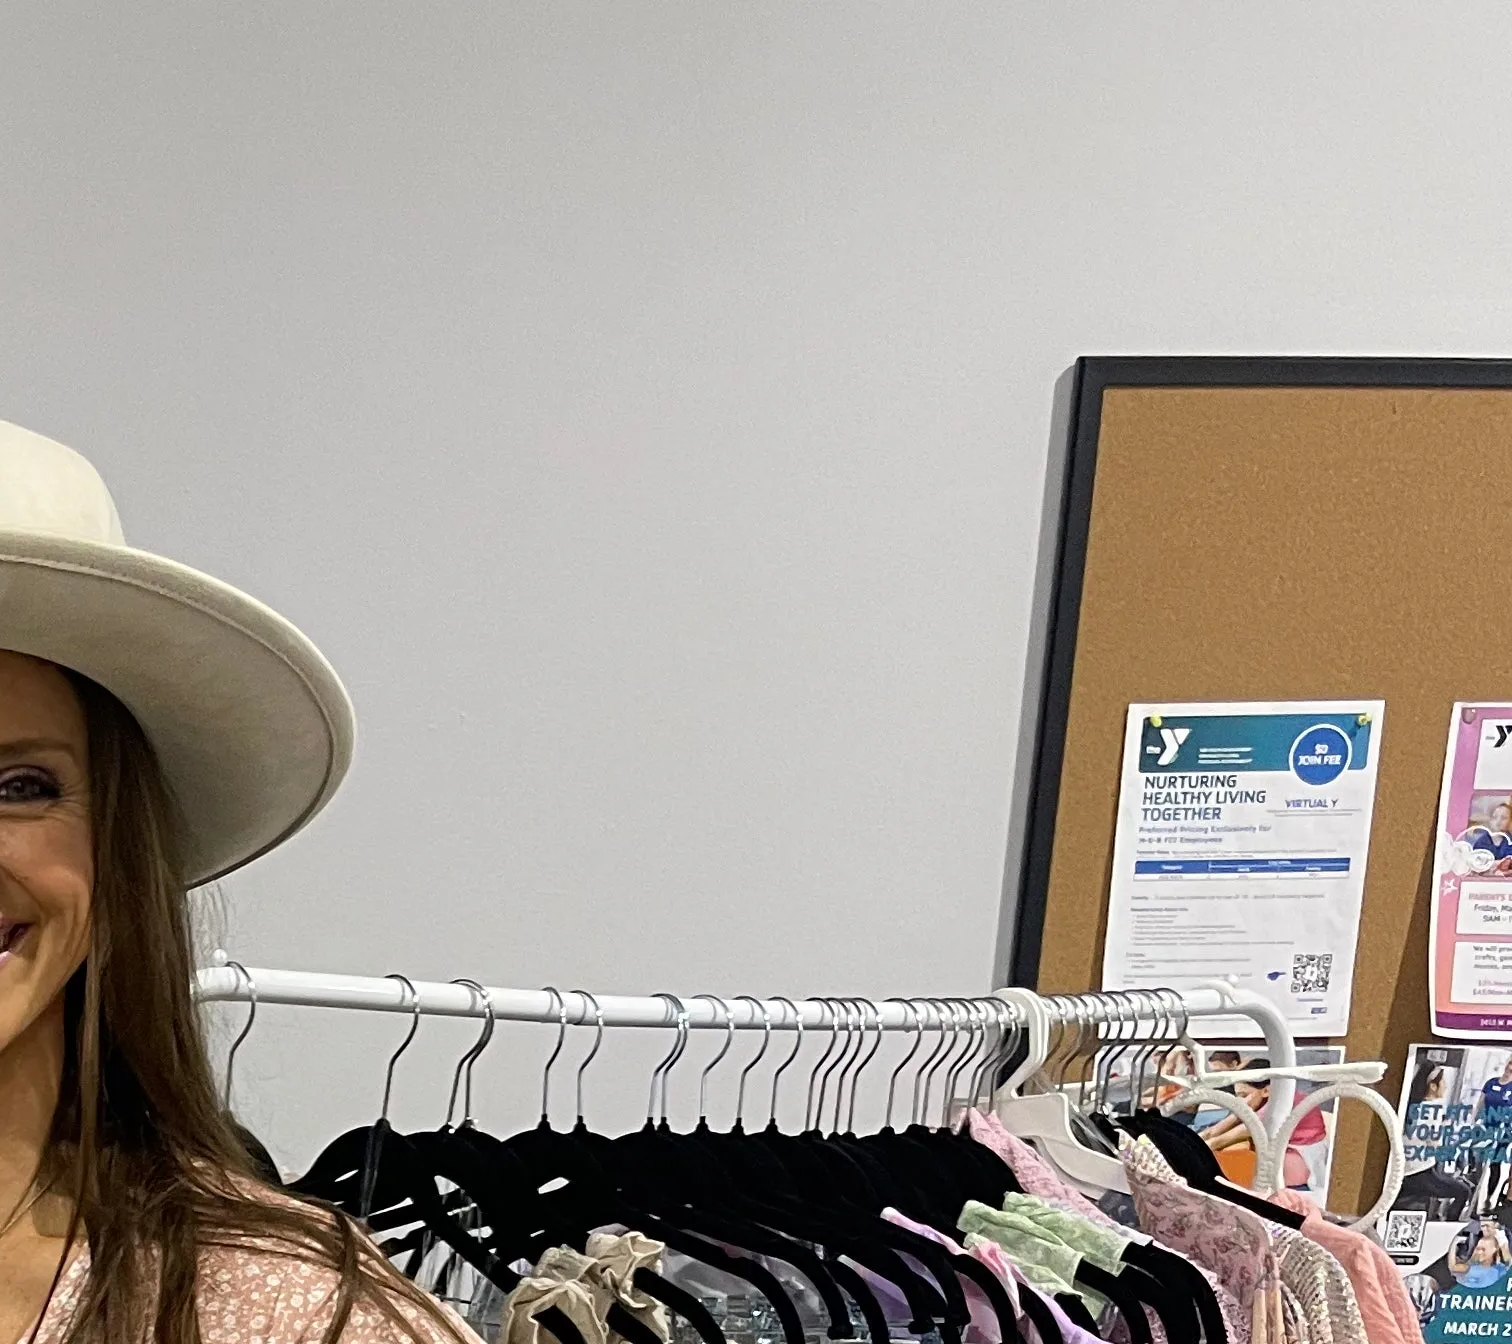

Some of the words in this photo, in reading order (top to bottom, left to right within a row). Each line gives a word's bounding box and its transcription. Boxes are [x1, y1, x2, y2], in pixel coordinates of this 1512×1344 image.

[1298, 755, 1322, 766] JOIN
[1323, 754, 1342, 765] FEE
[1144, 774, 1238, 789] NURTURING
[1142, 791, 1212, 805] HEALTHY
[1215, 790, 1267, 804] LIVING
[1285, 799, 1328, 809] VIRTUAL
[1141, 807, 1222, 822] TOGETHER
[1474, 904, 1499, 913] Friday,
[1408, 1104, 1442, 1121] GET
[1406, 1123, 1456, 1145] YOUR
[1443, 1321, 1499, 1336] MARCH
